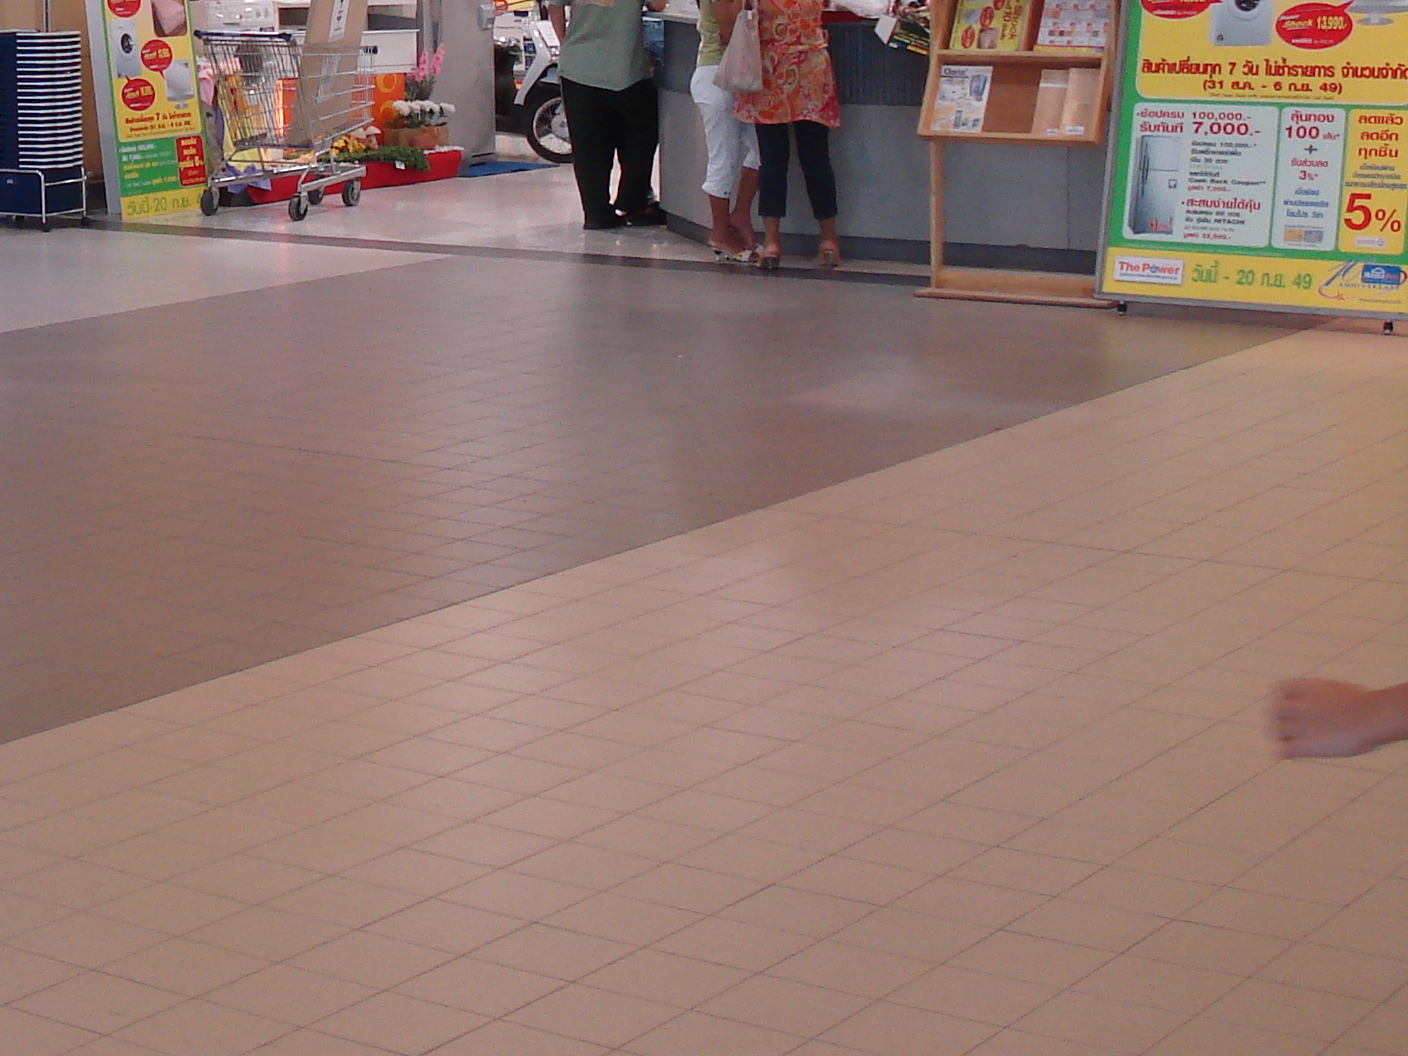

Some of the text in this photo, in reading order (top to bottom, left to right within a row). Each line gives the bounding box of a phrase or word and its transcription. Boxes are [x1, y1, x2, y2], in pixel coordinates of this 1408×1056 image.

[1228, 62, 1237, 75] 7
[1242, 59, 1259, 76] วัน
[1358, 113, 1403, 126] ลดแล้ว
[1285, 125, 1320, 139] 100
[1360, 129, 1399, 142] ลดอีก
[1343, 192, 1401, 233] 5%
[1118, 261, 1181, 276] The Power
[1236, 270, 1254, 286] 20
[1292, 273, 1313, 290] 49
